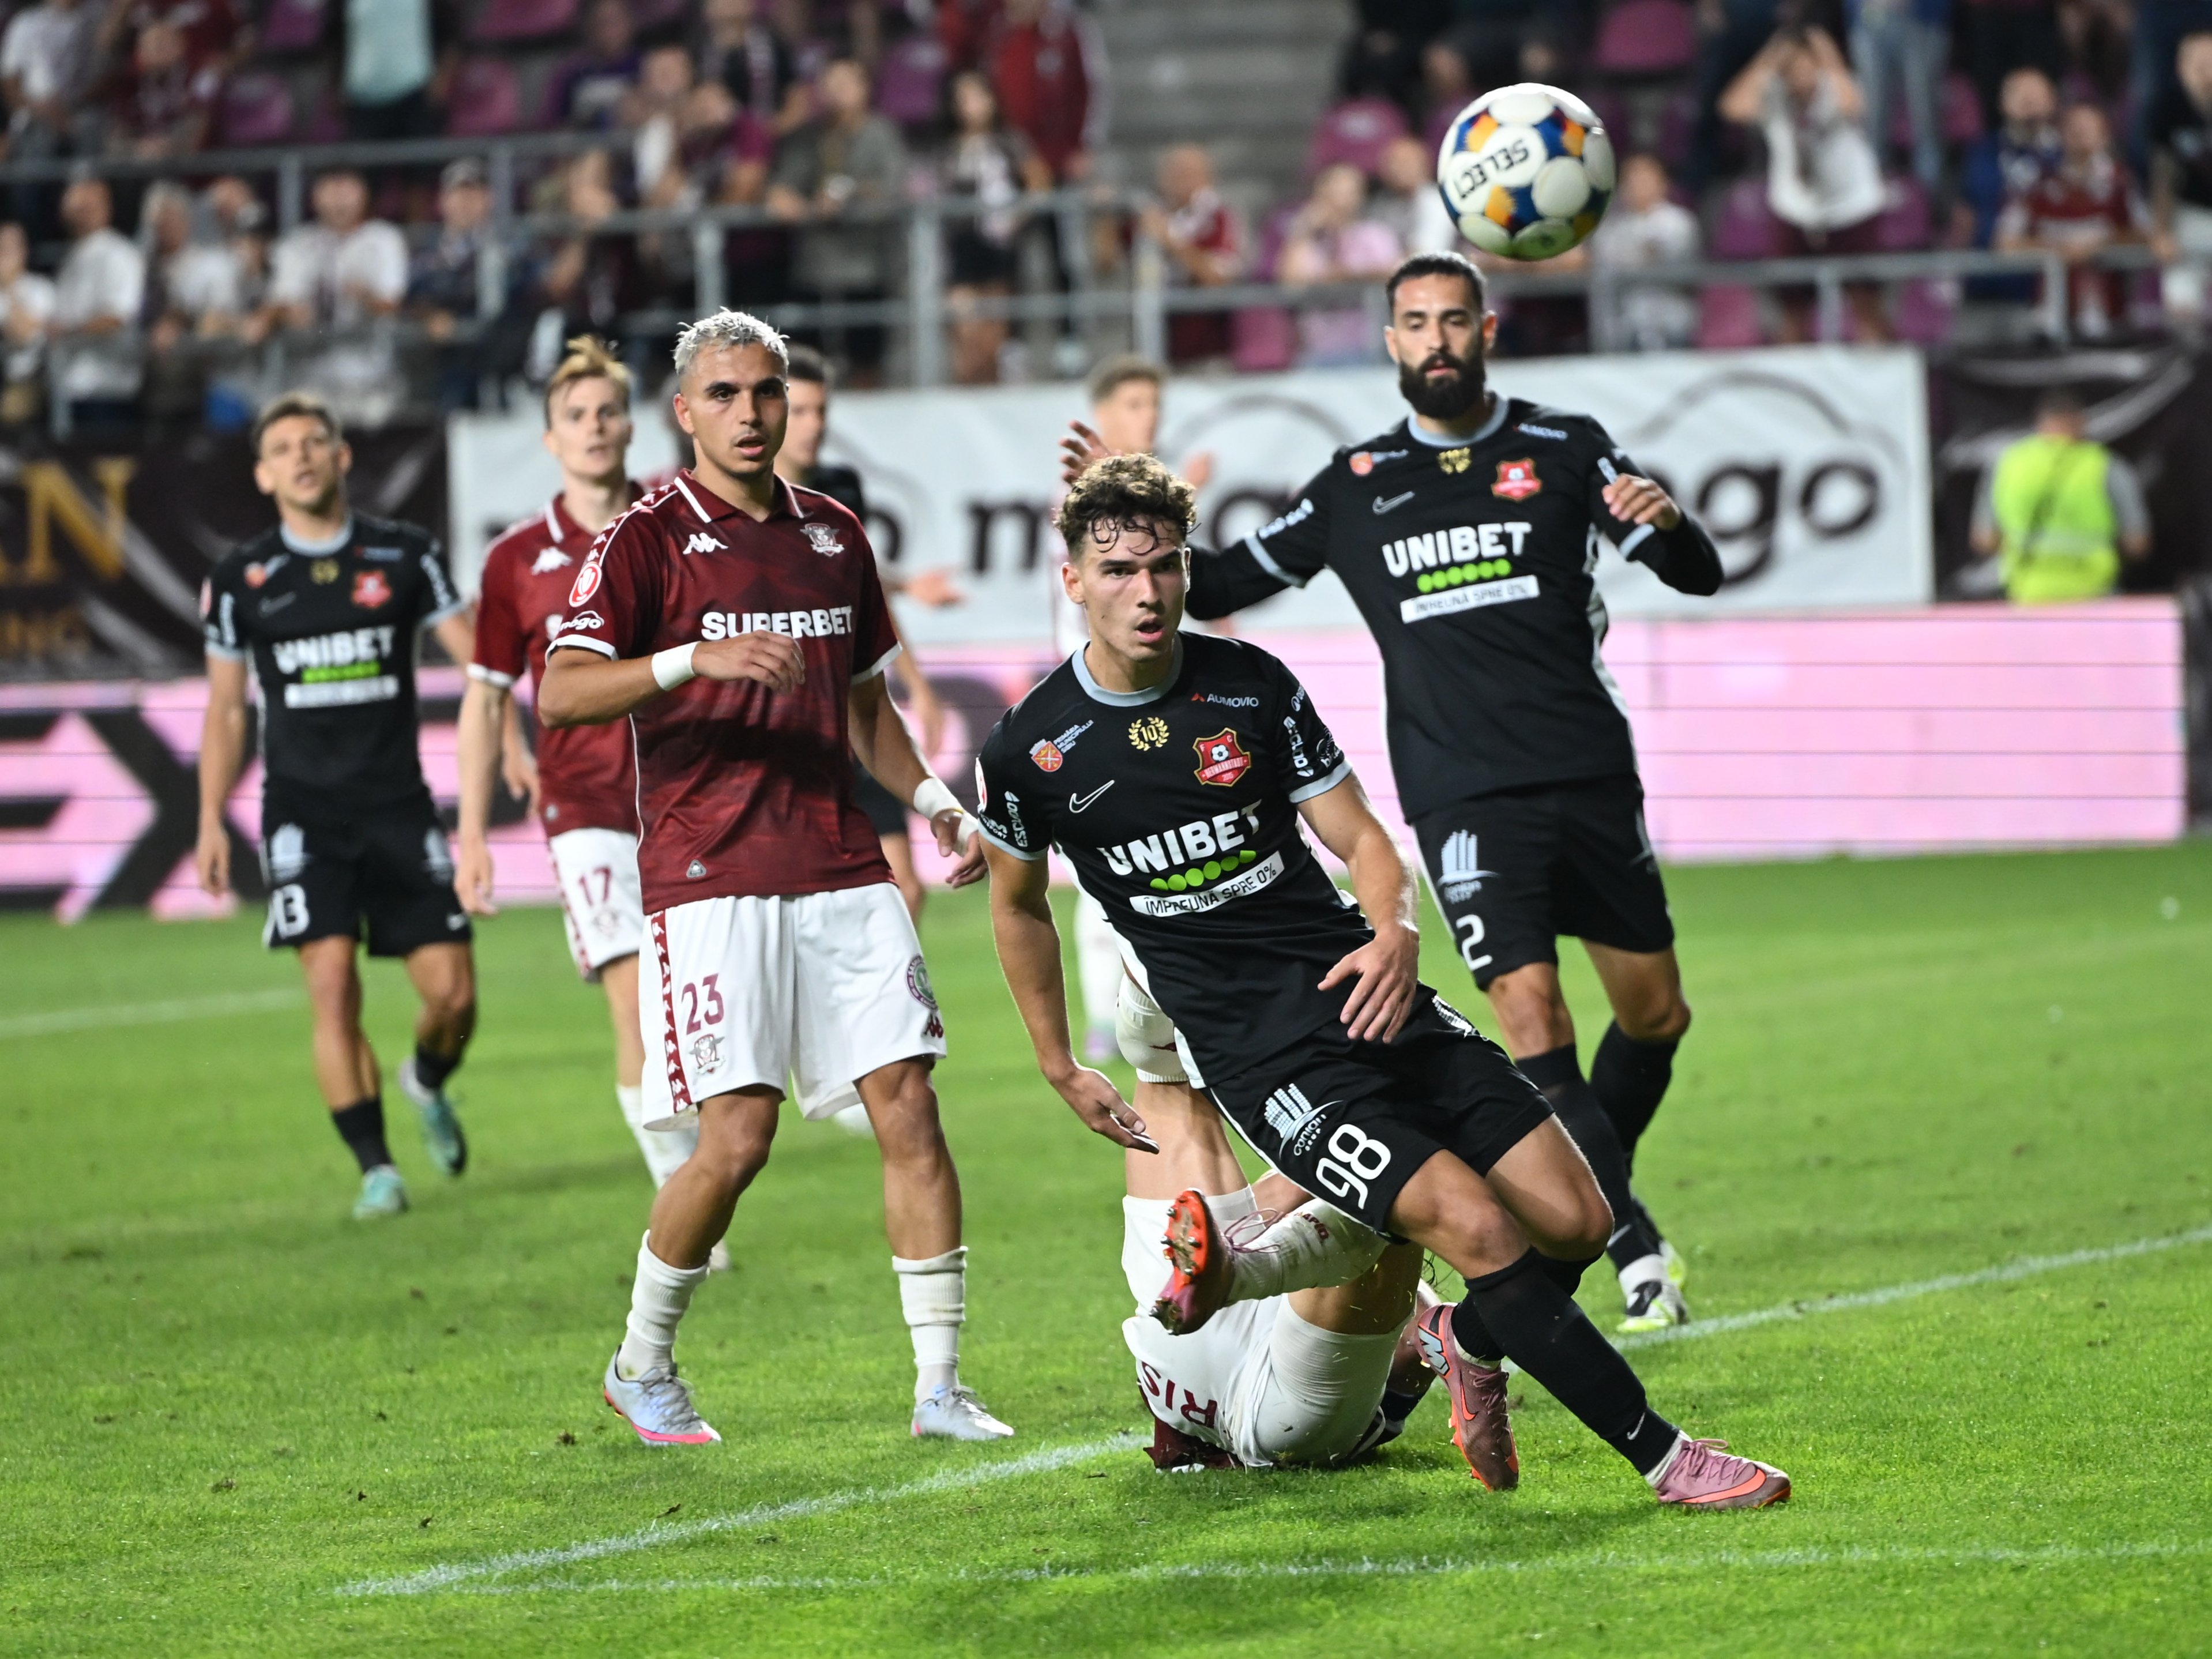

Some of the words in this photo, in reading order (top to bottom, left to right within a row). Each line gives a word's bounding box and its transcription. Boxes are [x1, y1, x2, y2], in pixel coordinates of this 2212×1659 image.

[1454, 139, 1530, 200] SELECT
[1382, 521, 1532, 577] UNIBET
[701, 605, 852, 640] SUPERBET
[273, 626, 394, 674] UNIBET
[1207, 693, 1259, 708] AUMOVIO
[1140, 725, 1158, 742] 10
[1096, 799, 1262, 875] UNIBET
[579, 866, 612, 907] 17
[1221, 875, 1257, 899] SPRE
[1258, 863, 1277, 884] 0%
[1456, 914, 1493, 971] 2
[682, 973, 724, 1035] 23
[1316, 1124, 1391, 1209] 98
